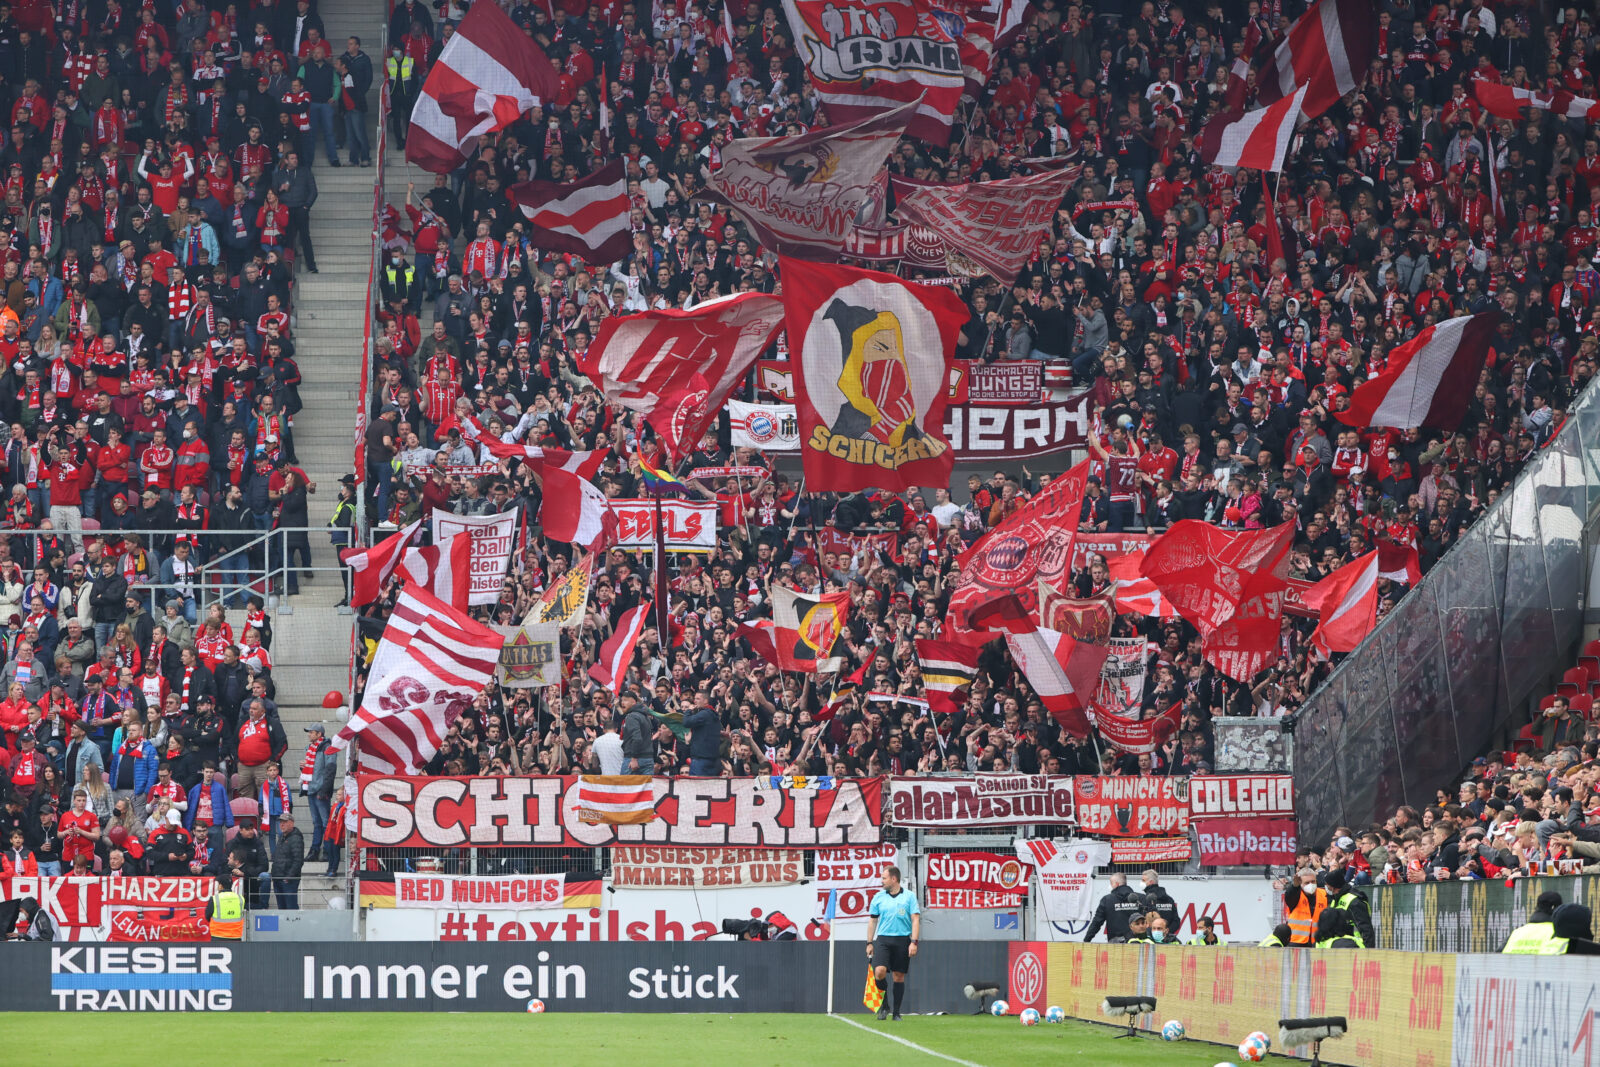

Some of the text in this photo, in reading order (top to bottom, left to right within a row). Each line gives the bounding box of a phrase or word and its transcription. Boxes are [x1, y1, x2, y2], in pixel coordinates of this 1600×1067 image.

[971, 375, 1040, 391] JUNGS!
[1118, 467, 1135, 486] 72
[618, 509, 703, 542] EBELS
[502, 645, 547, 665] ULTRAS
[976, 775, 1047, 793] Sektion SV
[1101, 777, 1173, 800] MUNICH'S
[1190, 777, 1293, 814] COLEGIO
[1079, 803, 1189, 832] RED PRIDE
[818, 843, 894, 862] WIR SIND
[1114, 851, 1190, 861] IMMER ANWESEND
[613, 862, 800, 886] IMMER BEI UNS
[817, 865, 853, 881] BEI
[929, 854, 1029, 888] SÜDTIROL
[400, 878, 443, 902] RED
[927, 888, 980, 908] LETZTE
[51, 946, 232, 974] KIESER
[303, 950, 740, 1000] Immer ein Stück
[51, 989, 233, 1011] TRAINING
